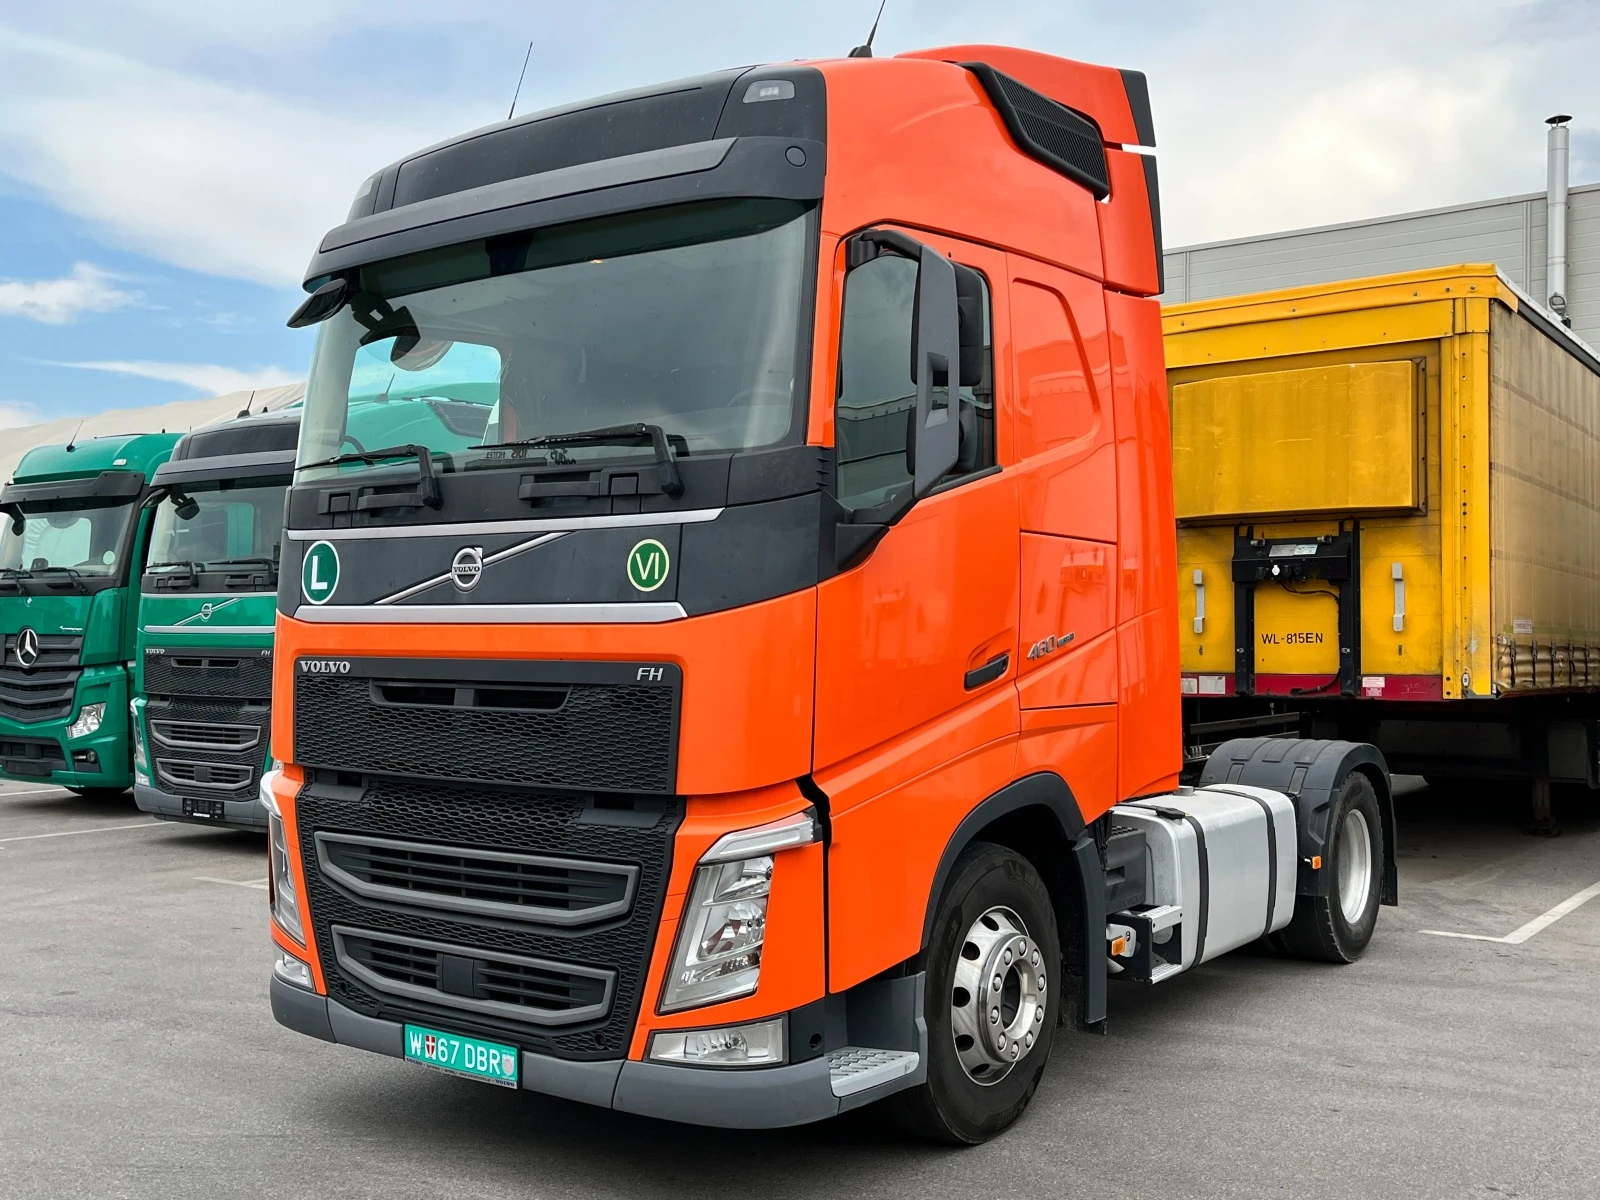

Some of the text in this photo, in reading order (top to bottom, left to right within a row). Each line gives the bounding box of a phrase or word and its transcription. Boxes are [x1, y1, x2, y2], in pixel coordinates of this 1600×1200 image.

[310, 555, 328, 590] L
[635, 552, 660, 580] VI
[1027, 634, 1056, 660] 460
[1261, 632, 1323, 645] WL-815EN
[299, 660, 351, 674] VOLVO
[636, 667, 664, 682] FH
[438, 1038, 460, 1065] 67
[464, 1043, 501, 1076] DBR
[495, 1079, 515, 1088] VOLVO
